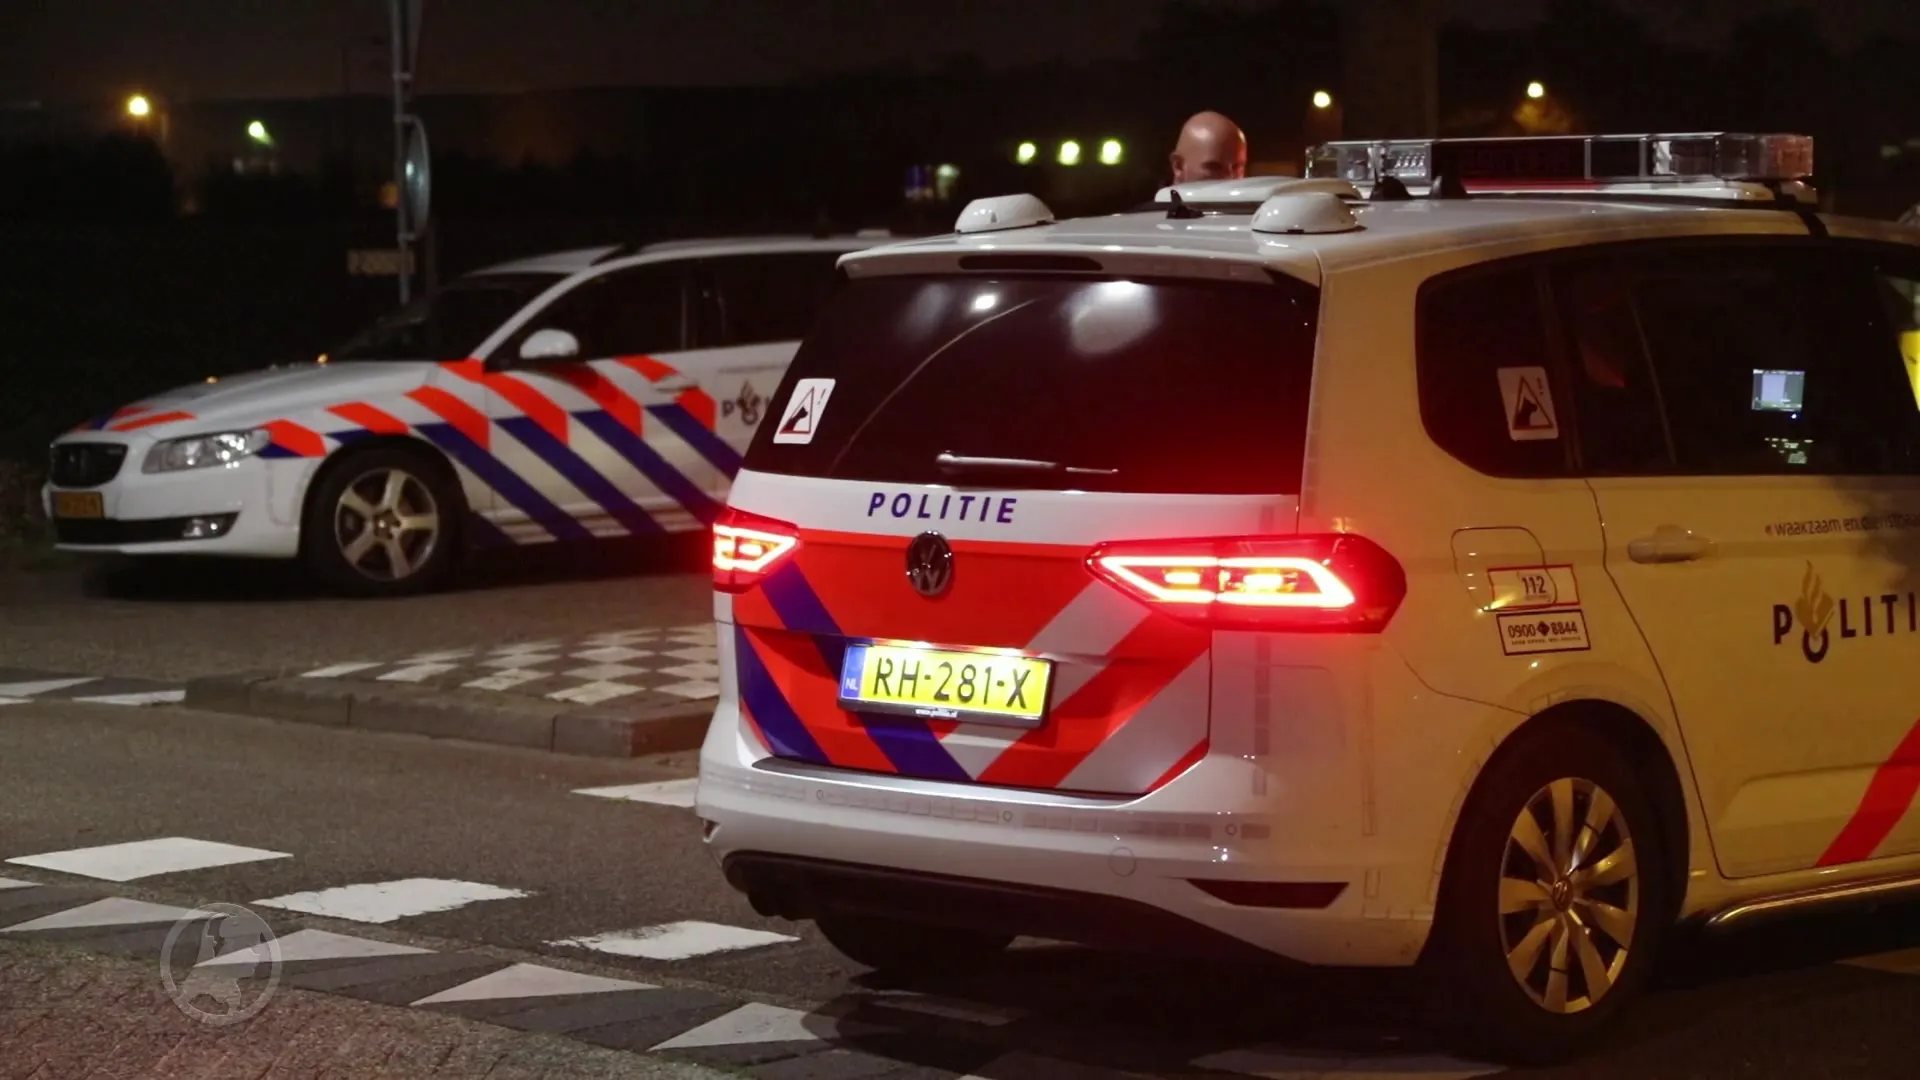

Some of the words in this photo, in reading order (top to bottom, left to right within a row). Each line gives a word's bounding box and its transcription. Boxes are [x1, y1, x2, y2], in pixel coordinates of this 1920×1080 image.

[867, 492, 1017, 523] POLITIE
[1774, 519, 1841, 536] waakzaam
[1522, 575, 1547, 595] 112
[1507, 624, 1536, 638] 0900
[1550, 621, 1578, 635] 8844
[873, 656, 1030, 709] RH-281-X
